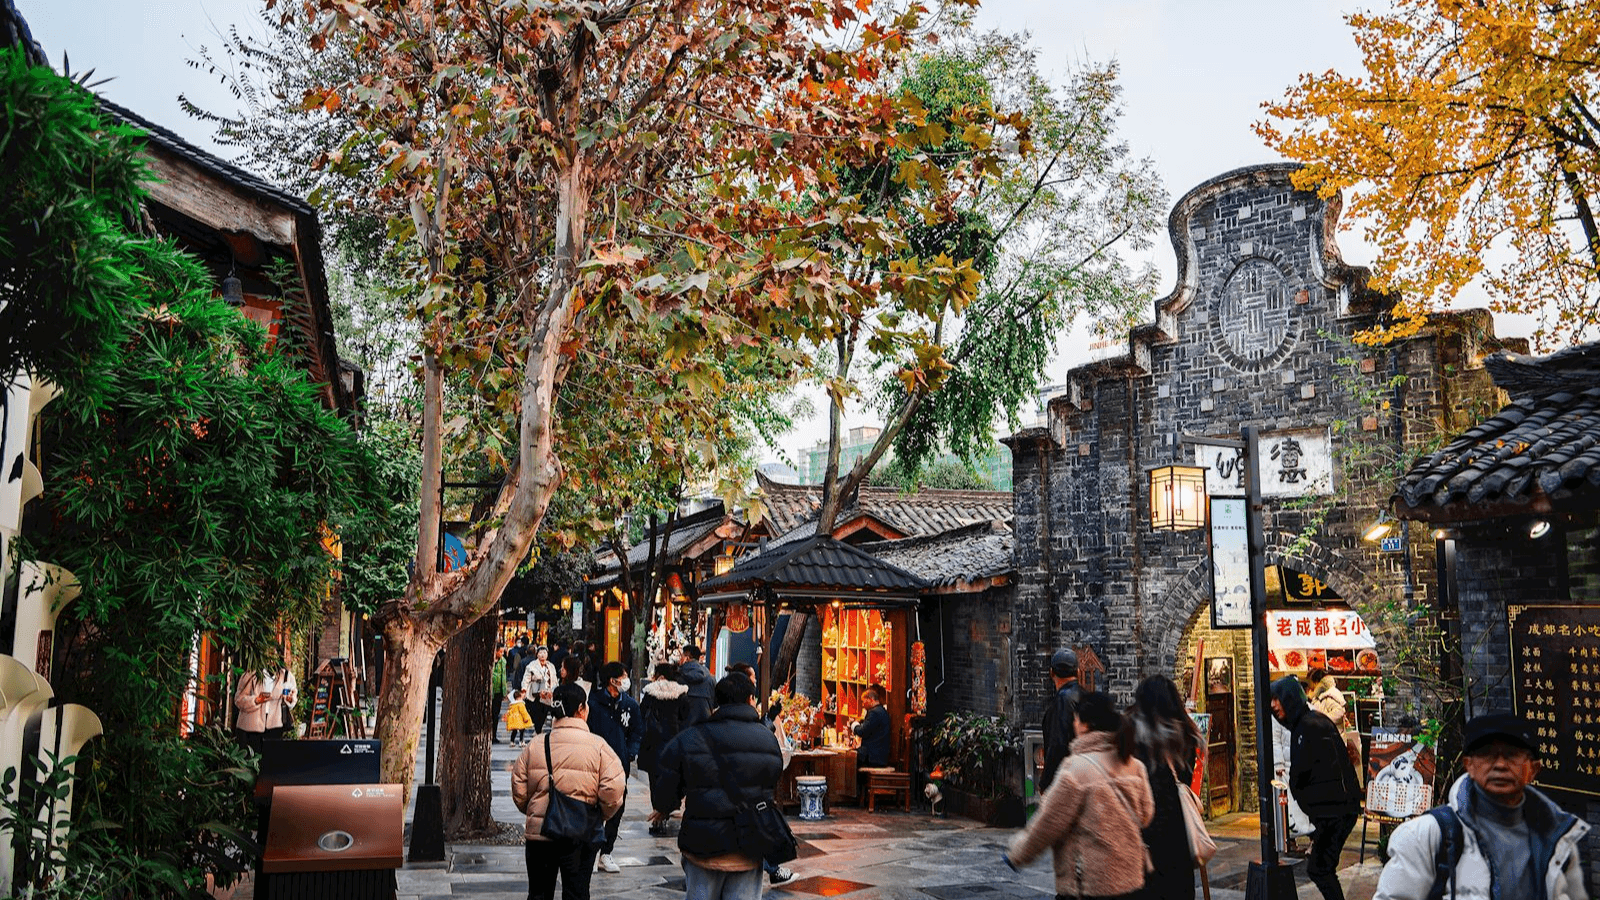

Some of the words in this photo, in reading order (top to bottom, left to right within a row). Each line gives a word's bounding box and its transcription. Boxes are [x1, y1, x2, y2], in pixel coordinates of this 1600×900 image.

[1277, 616, 1366, 636] 老成都名小
[1528, 623, 1600, 637] 成都名小吃
